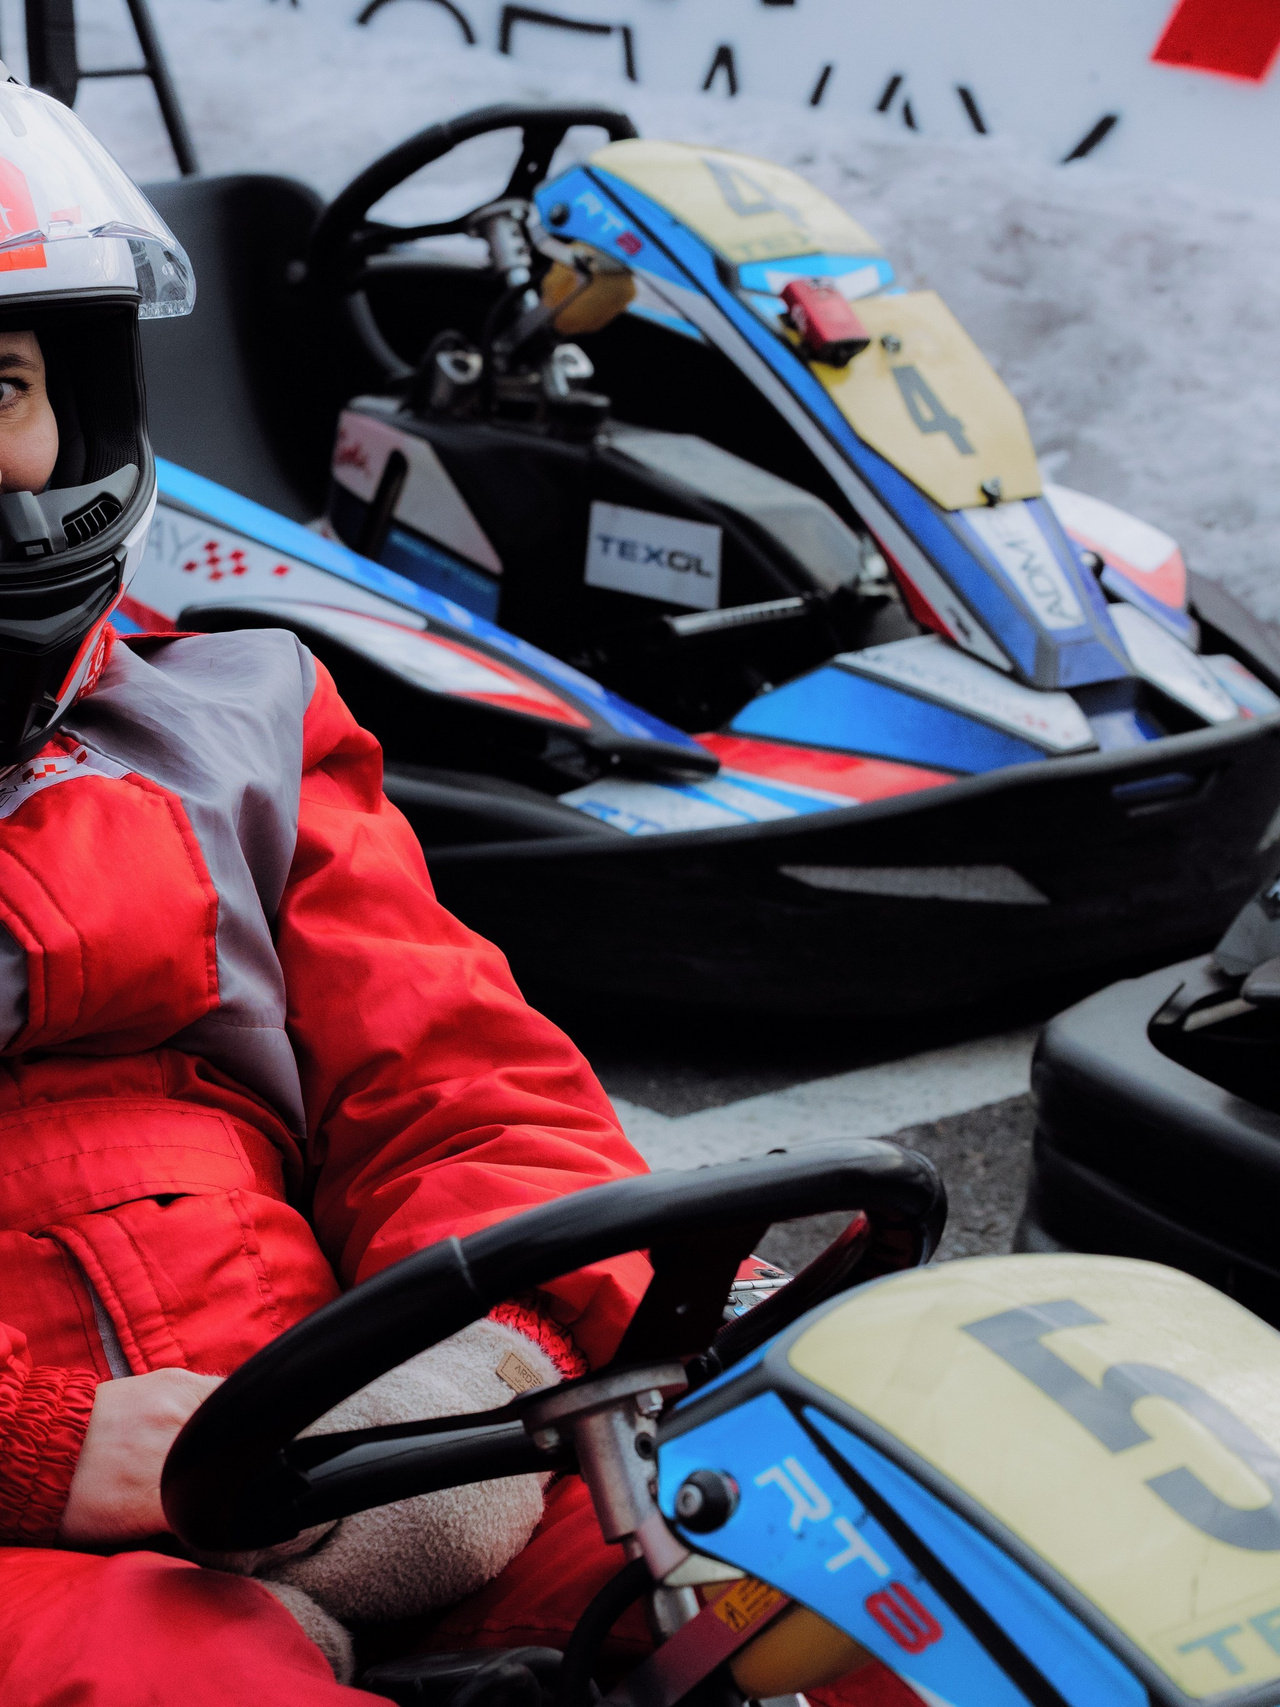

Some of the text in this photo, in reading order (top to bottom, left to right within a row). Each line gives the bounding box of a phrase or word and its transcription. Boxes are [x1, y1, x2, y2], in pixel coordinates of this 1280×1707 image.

[890, 364, 977, 455] 4
[596, 532, 713, 579] TEXOL
[959, 1298, 1280, 1553] 5
[754, 1455, 945, 1656] RT8
